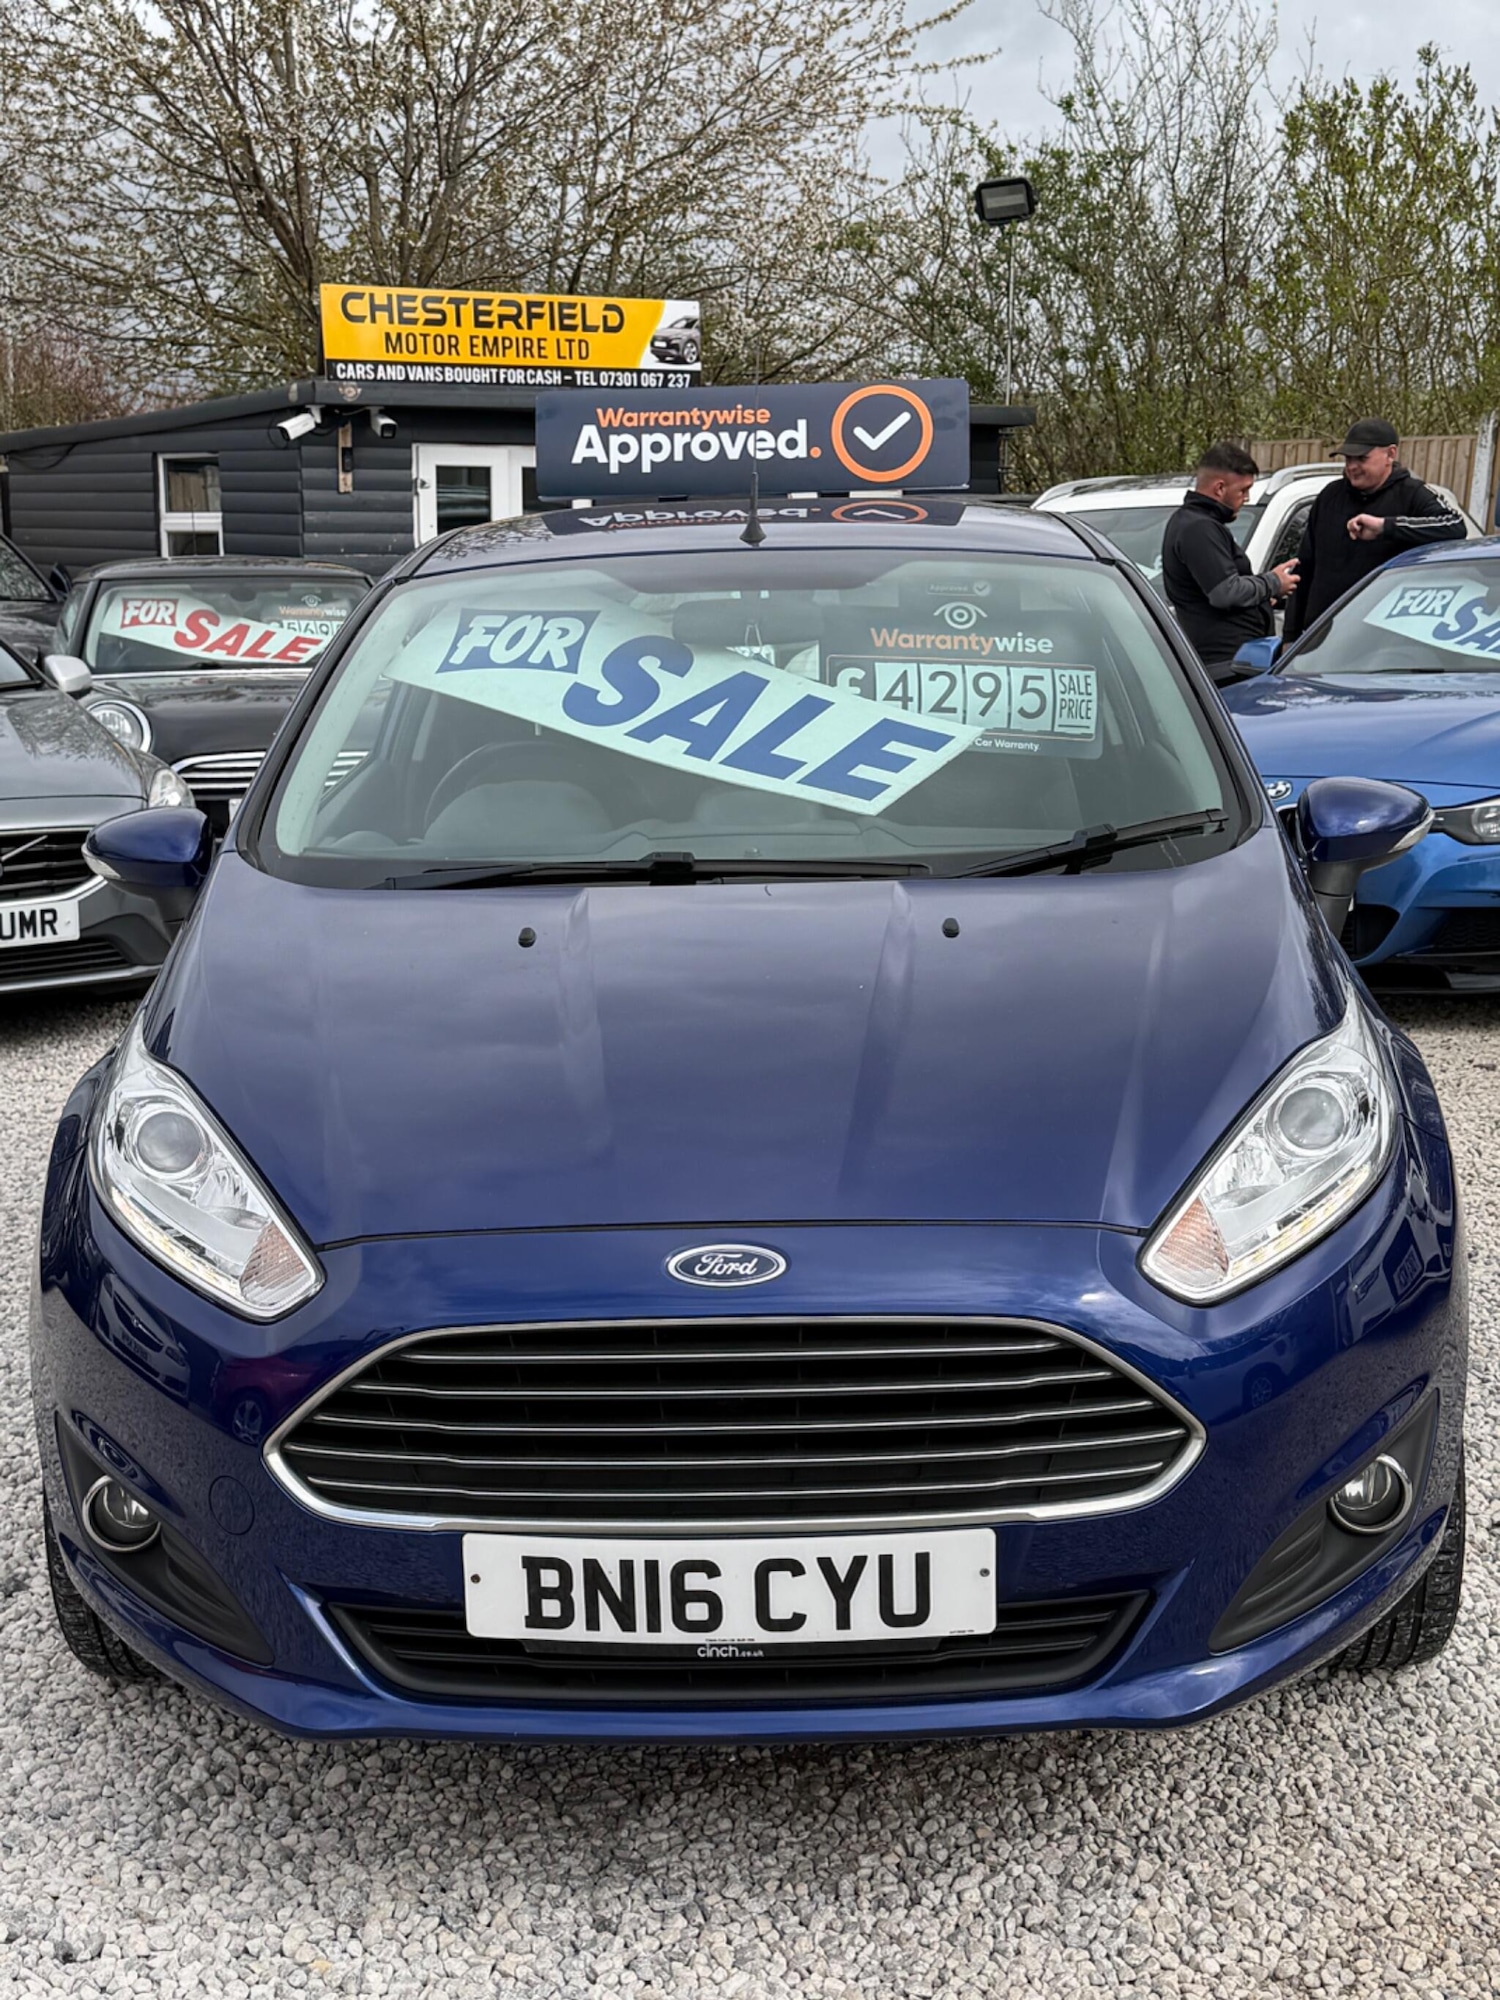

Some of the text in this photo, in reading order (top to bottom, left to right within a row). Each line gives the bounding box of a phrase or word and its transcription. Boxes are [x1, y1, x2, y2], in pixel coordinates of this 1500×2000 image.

[340, 291, 625, 333] CHESTERFIELD
[384, 331, 590, 360] MOTOR EMPIRE LTD
[336, 362, 375, 380] CARS
[376, 364, 406, 381] AND
[407, 365, 443, 382] VANS
[444, 367, 499, 384] BOUGHT
[499, 368, 525, 384] FOR
[526, 369, 562, 385] CASH
[574, 370, 598, 387] TEL
[599, 372, 638, 387] 07301
[640, 373, 664, 388] 067
[667, 373, 691, 388] 237
[596, 404, 771, 430] Warrantywise
[571, 418, 822, 474] Approved.
[124, 602, 174, 625] FOR
[1390, 588, 1455, 616] FOR
[174, 609, 323, 662] SALE
[448, 611, 586, 668] FOR
[870, 627, 1054, 655] Warrantywise
[1059, 674, 1092, 696] SALE
[562, 635, 956, 802] SALE
[1059, 698, 1092, 720] PRICE
[975, 738, 992, 746] Car
[694, 1252, 758, 1275] Ford
[521, 1552, 931, 1633] BN16 CYU
